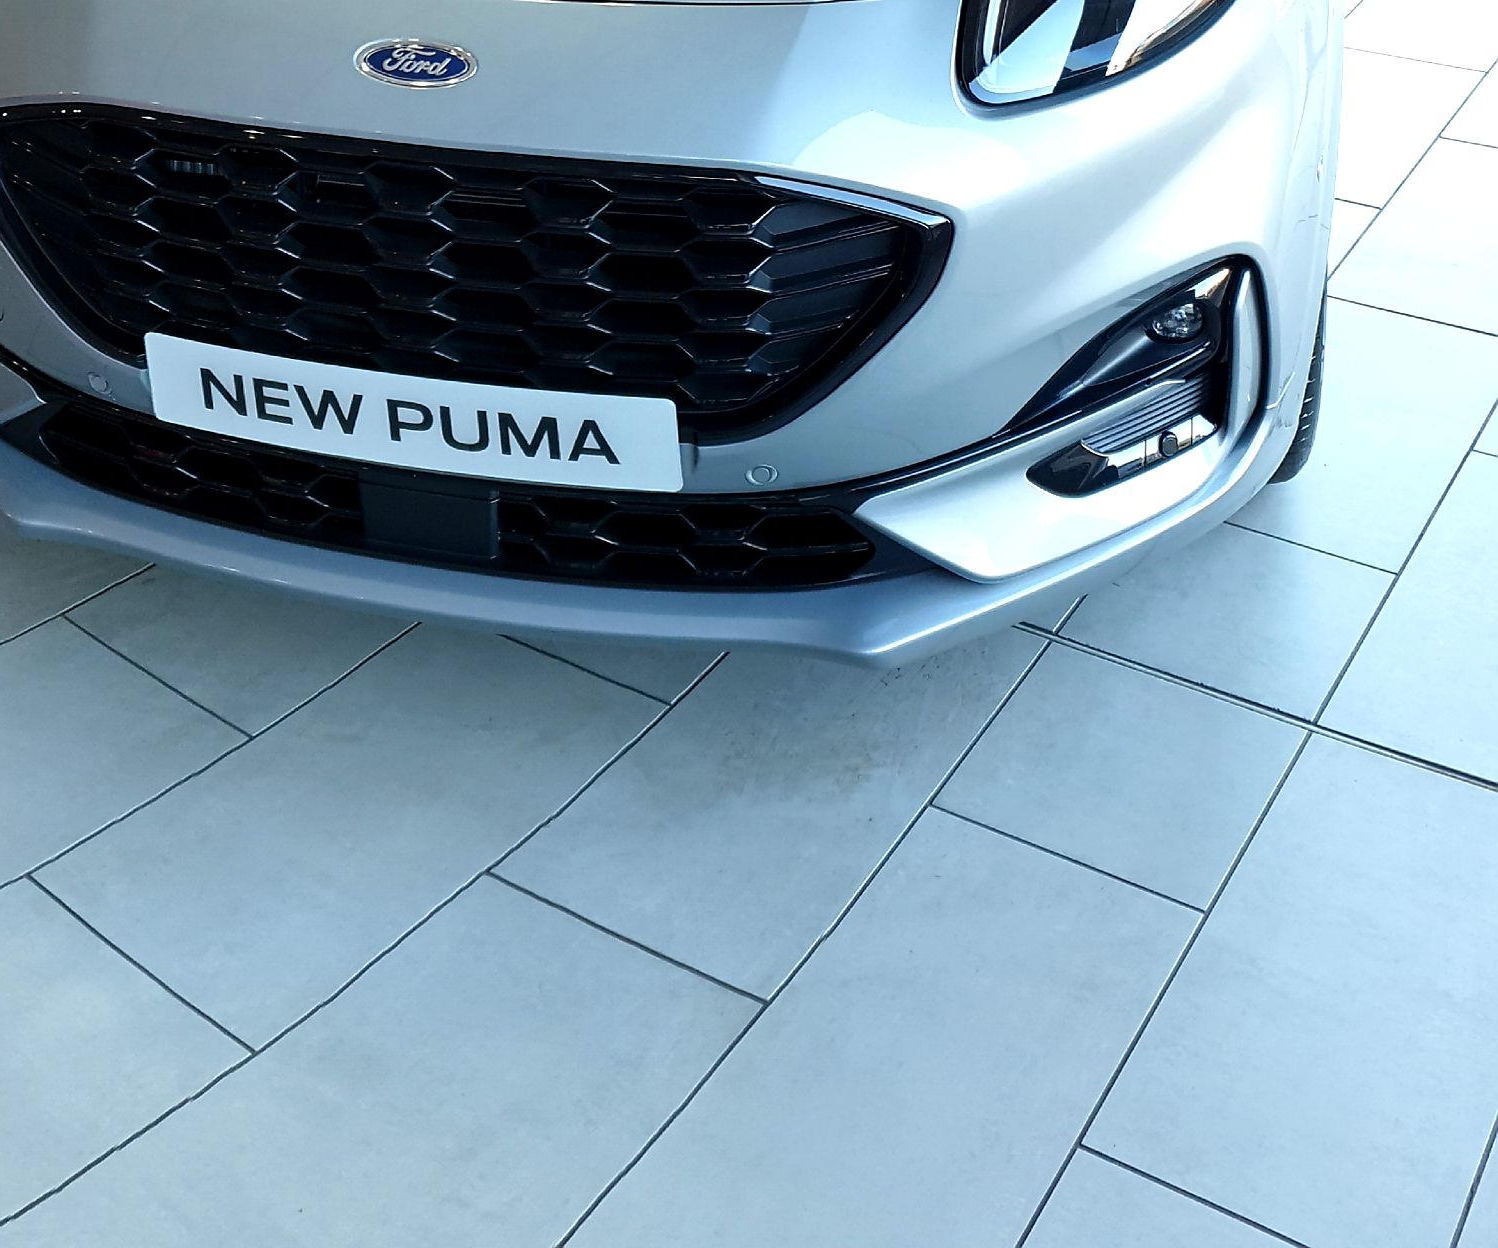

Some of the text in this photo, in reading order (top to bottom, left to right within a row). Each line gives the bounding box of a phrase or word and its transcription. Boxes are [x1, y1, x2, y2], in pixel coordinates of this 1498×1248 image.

[382, 47, 452, 76] Ford
[199, 367, 621, 465] NEW PUMA
